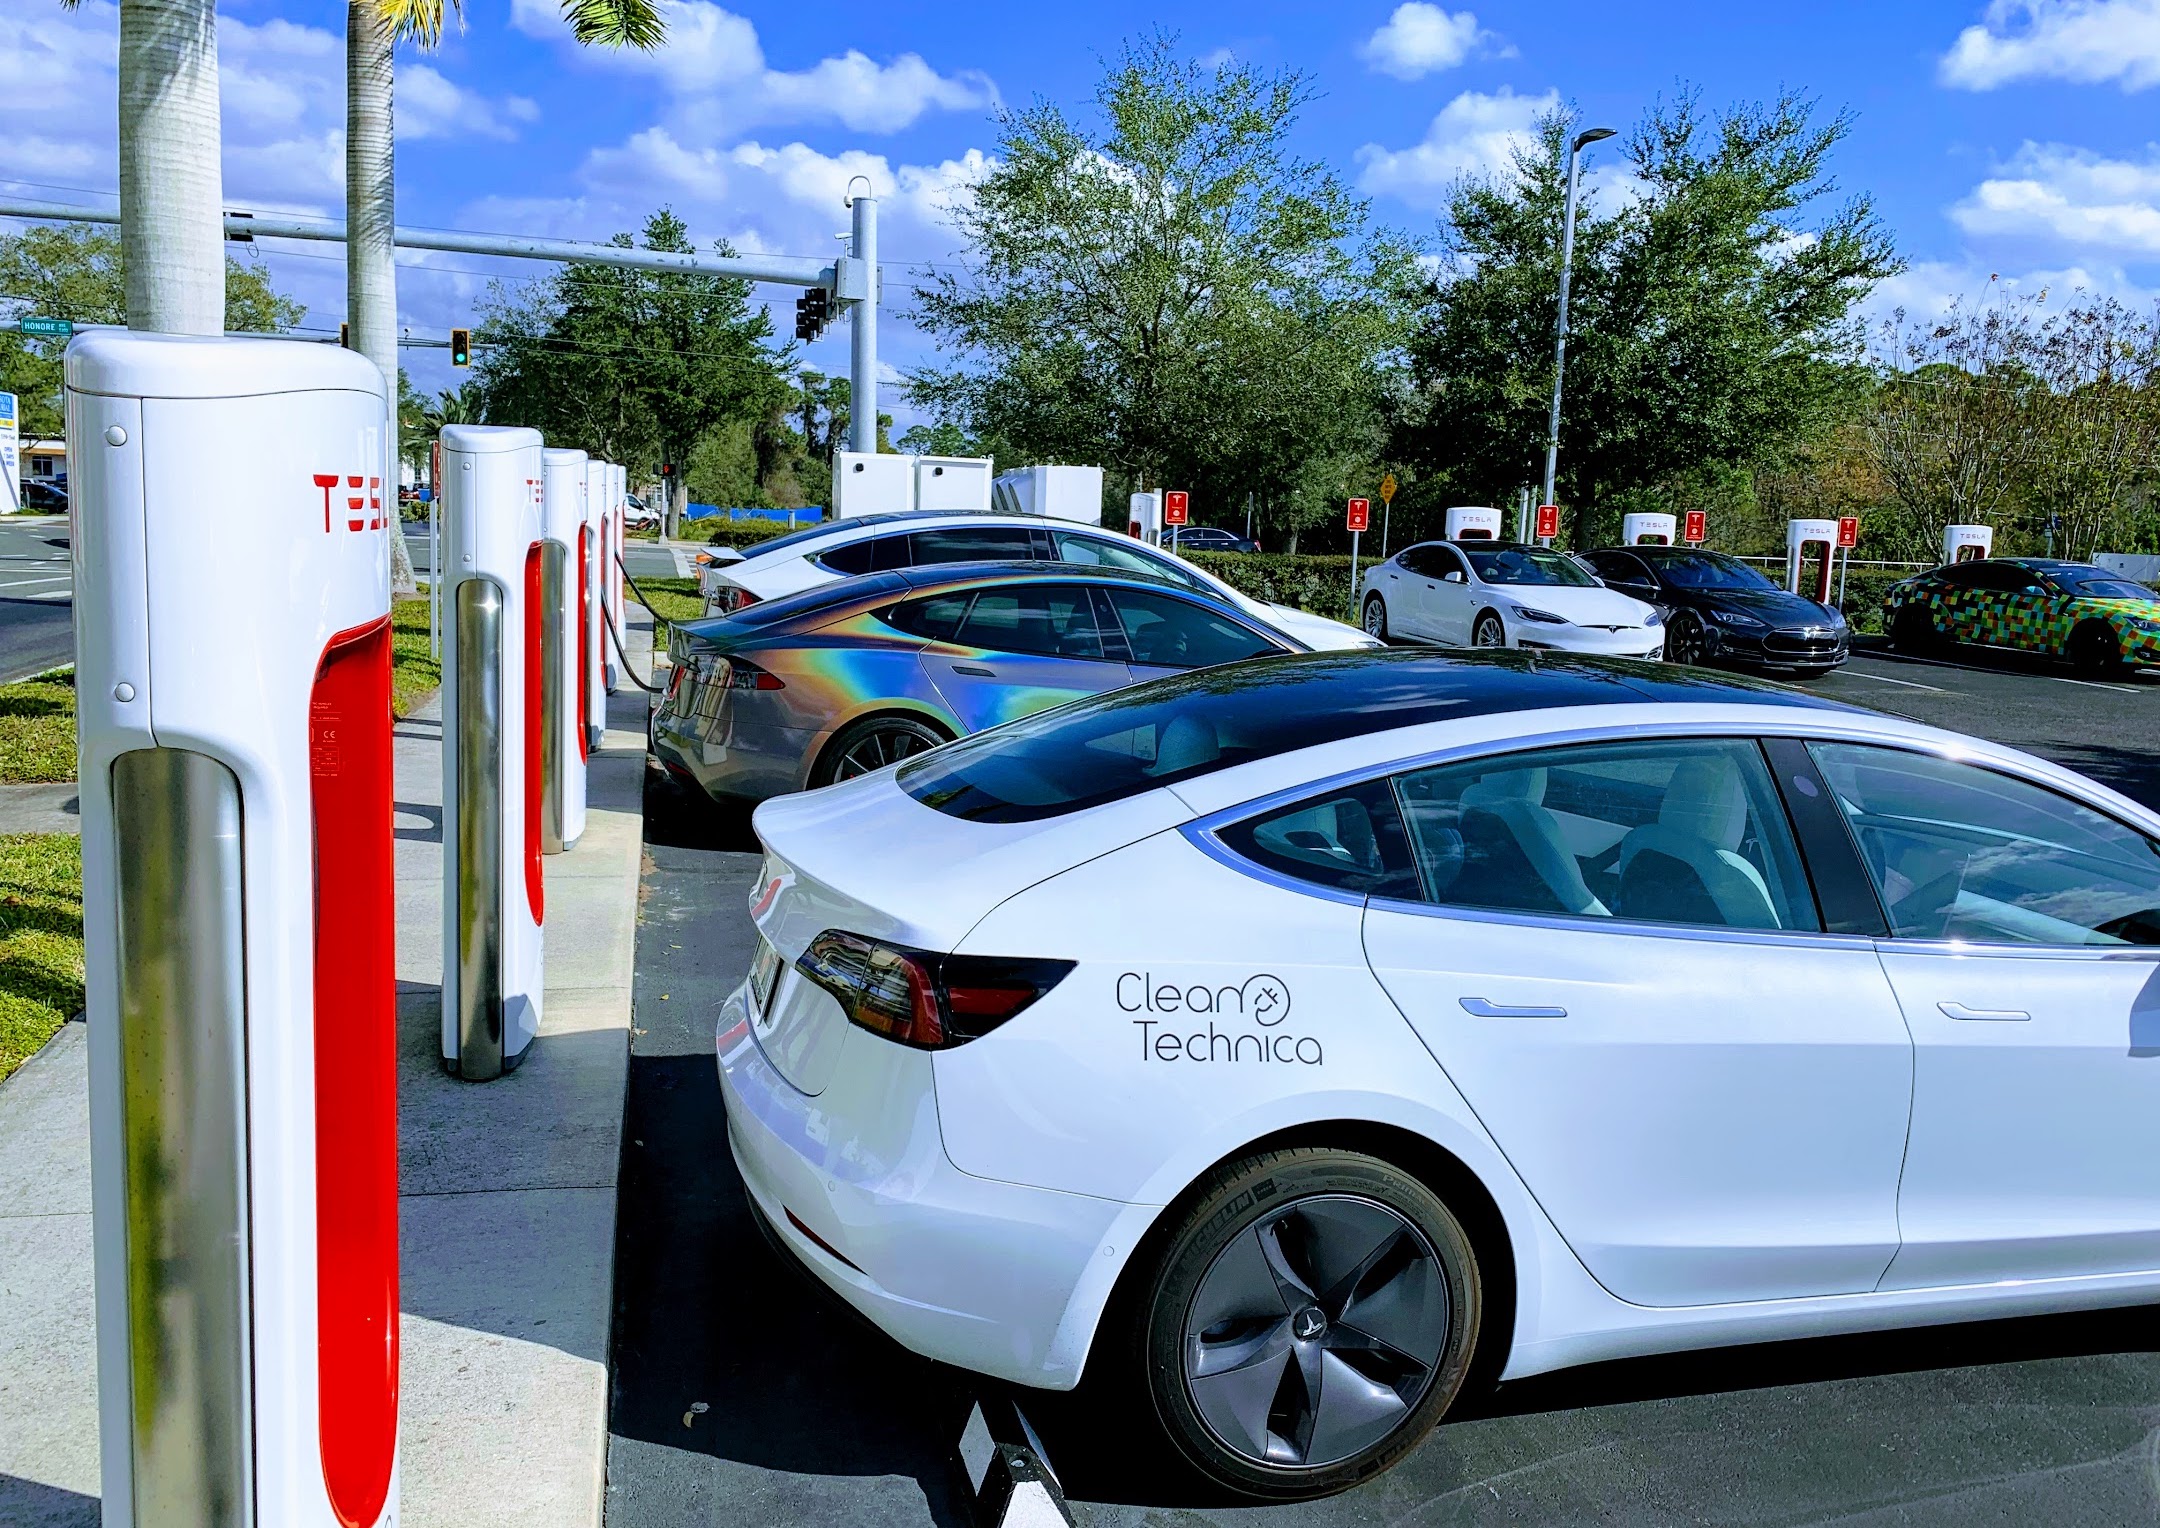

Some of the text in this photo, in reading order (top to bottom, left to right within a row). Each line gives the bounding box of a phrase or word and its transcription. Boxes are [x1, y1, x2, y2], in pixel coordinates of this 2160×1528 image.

[24, 322, 56, 331] HONORE
[1116, 972, 1244, 1013] Clean
[1132, 1020, 1323, 1066] Technica
